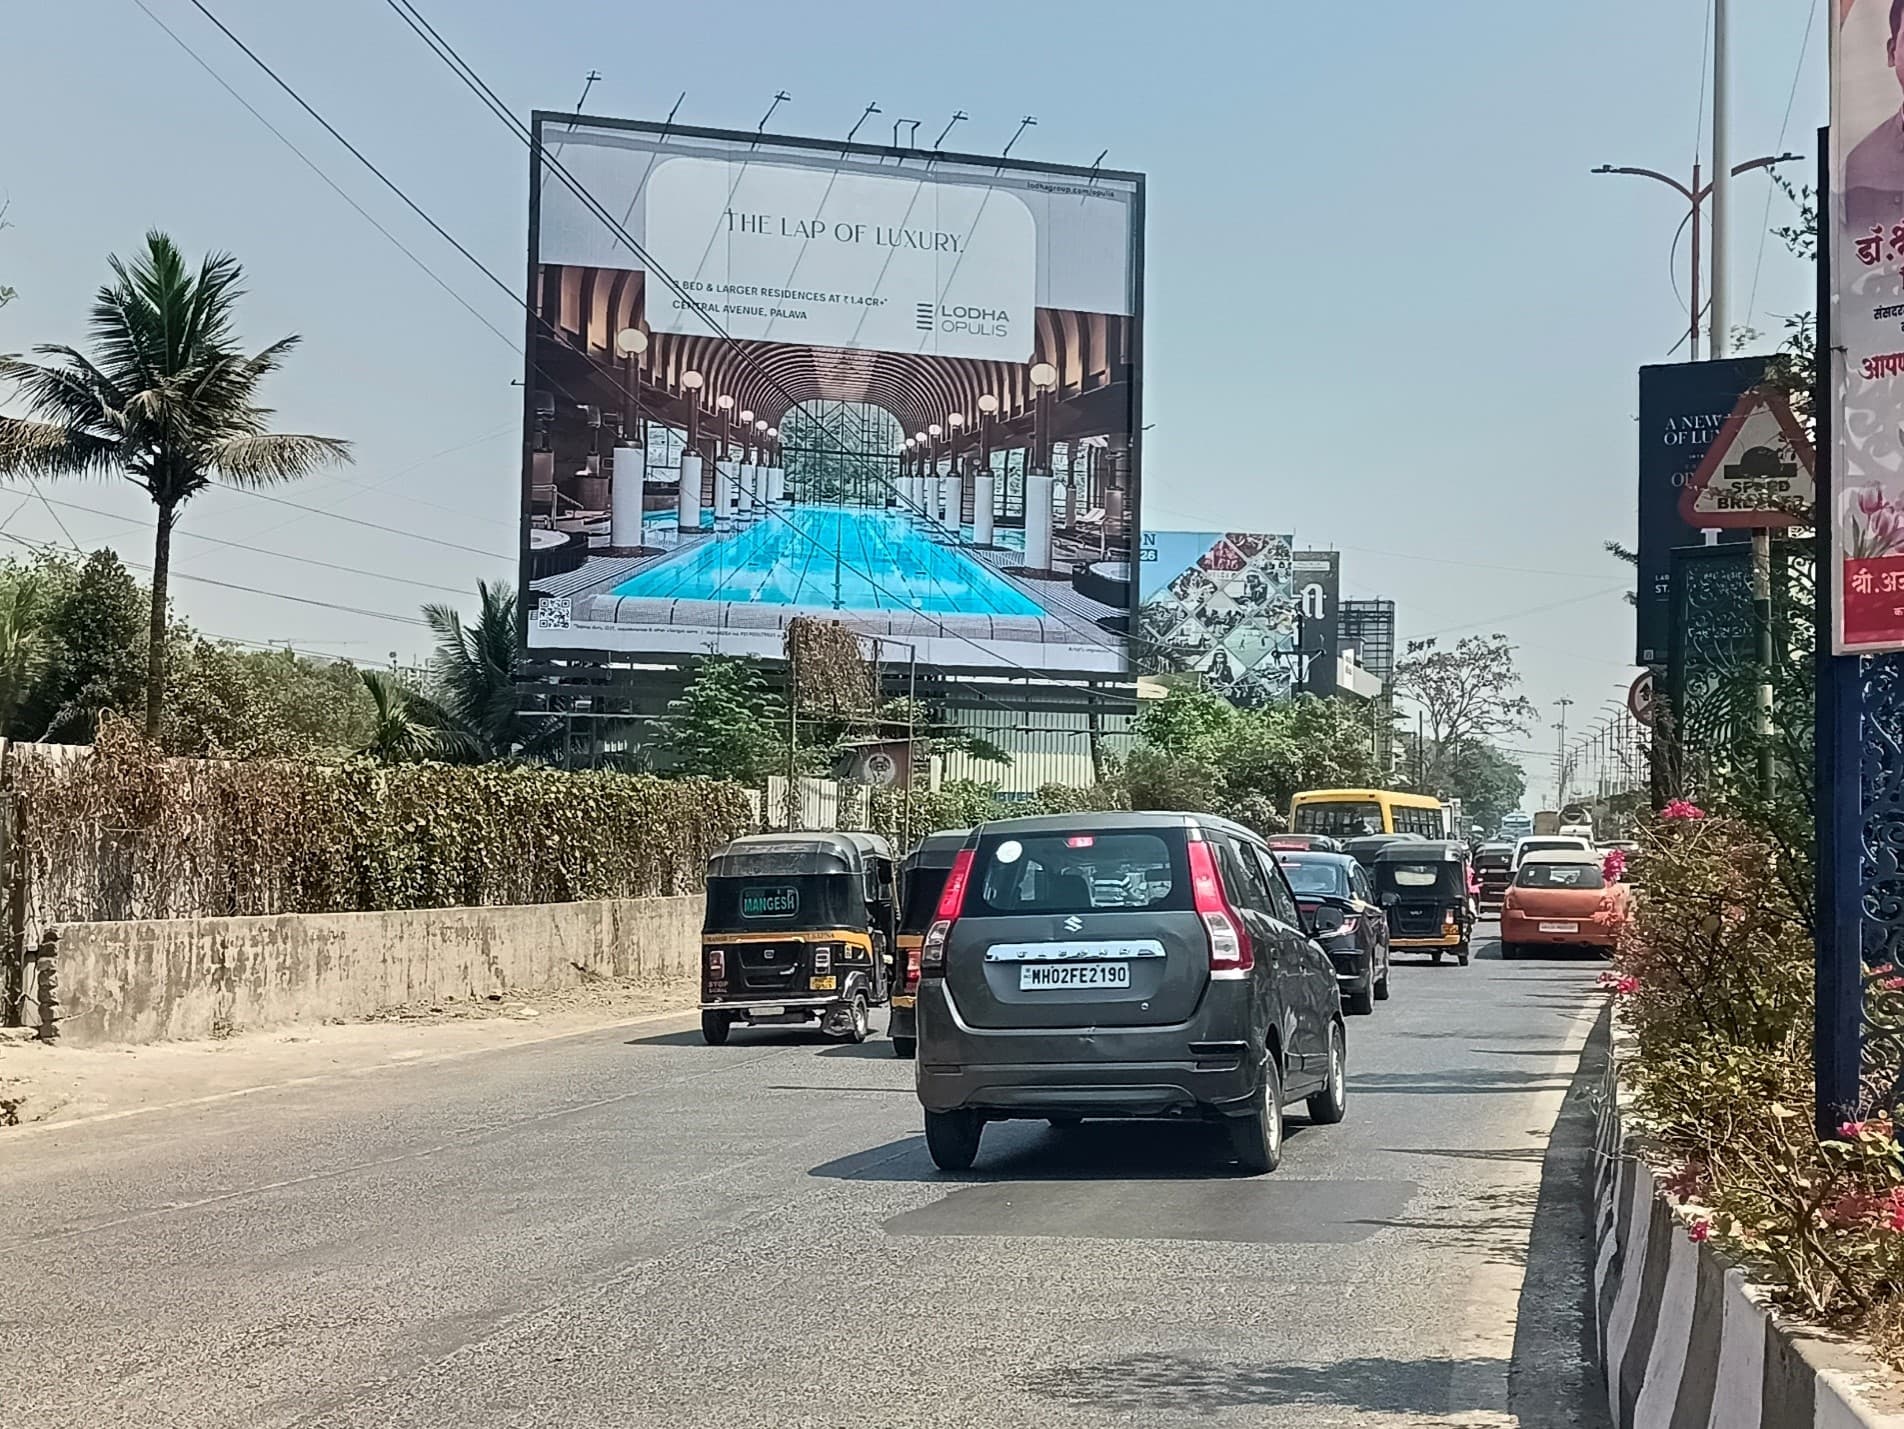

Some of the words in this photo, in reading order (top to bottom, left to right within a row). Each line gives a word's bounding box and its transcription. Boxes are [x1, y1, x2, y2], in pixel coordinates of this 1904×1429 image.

[724, 208, 772, 235] THE
[781, 217, 826, 239] LAP
[834, 223, 867, 243] OF
[876, 226, 964, 253] LUXURY.
[682, 280, 704, 292] BED
[706, 284, 714, 292] &
[716, 284, 758, 296] LARGER
[760, 287, 826, 303] RESIDENCES
[828, 293, 841, 303] AT
[722, 304, 768, 317] AVENUE,
[770, 307, 808, 320] PALAVA
[941, 304, 1010, 323] LODHA
[941, 319, 1008, 338] OPULIS
[1665, 417, 1677, 431] A
[1682, 414, 1722, 430] NEW
[1663, 431, 1688, 446] OF
[744, 896, 795, 912] MANGESH
[1031, 967, 1126, 985] MH02FE2190
